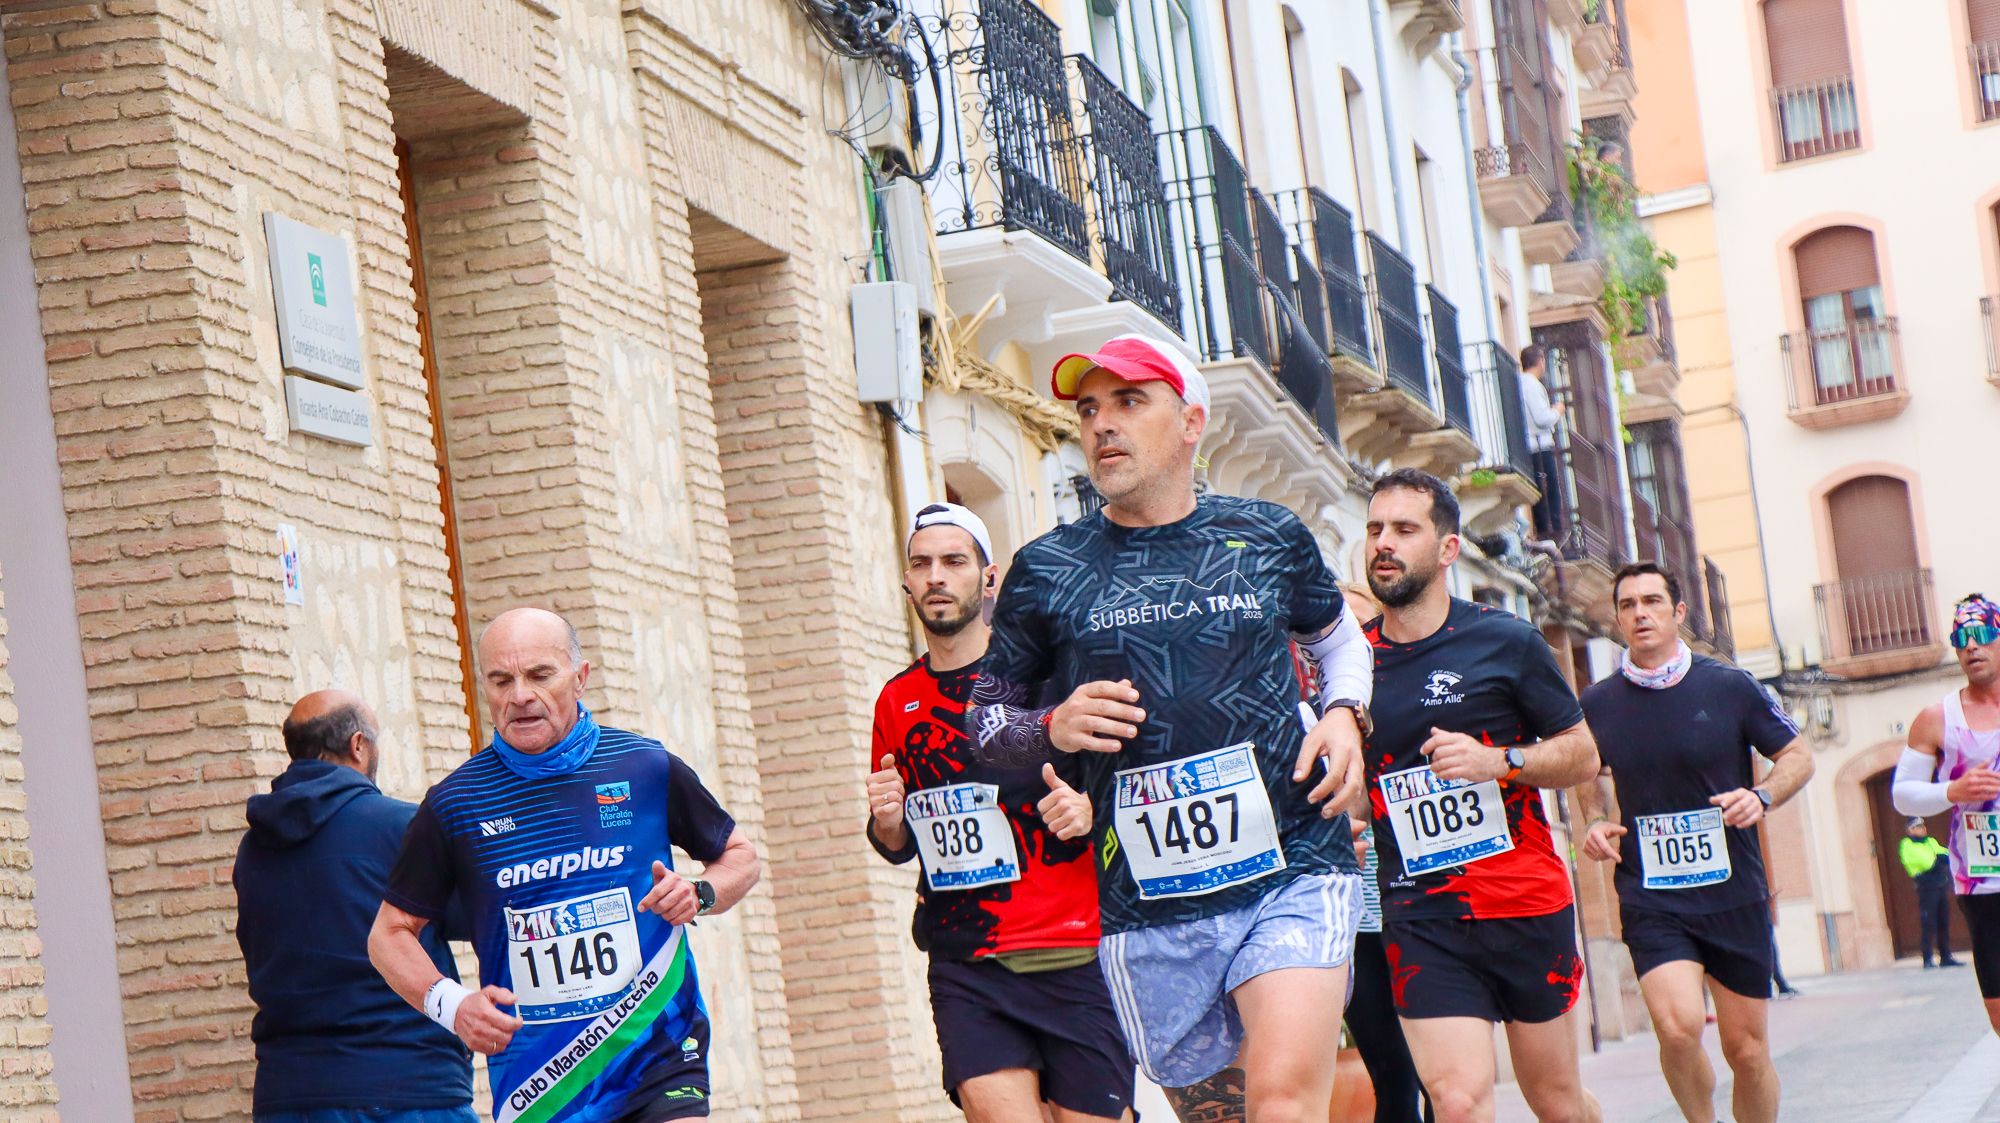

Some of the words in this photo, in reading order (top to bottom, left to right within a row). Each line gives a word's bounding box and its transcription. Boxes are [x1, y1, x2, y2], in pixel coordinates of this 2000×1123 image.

[1090, 601, 1203, 632] SUBBÉTICA
[1206, 593, 1262, 613] TRAIL
[1243, 611, 1263, 619] 2025
[1132, 769, 1175, 805] 21K
[1396, 771, 1431, 800] 21K
[495, 816, 513, 827] RUN
[600, 804, 619, 814] Club
[600, 810, 633, 821] Maratón
[602, 819, 632, 829] Lucena
[1405, 790, 1484, 841] 1083
[498, 823, 516, 834] PRO
[932, 817, 983, 858] 938
[1136, 792, 1239, 858] 1487
[1653, 834, 1713, 866] 1055
[513, 910, 557, 941] 21K
[520, 931, 619, 988] 1146
[510, 1073, 549, 1113] Club
[544, 1026, 610, 1080] Maratón
[604, 969, 660, 1029] Lucena
